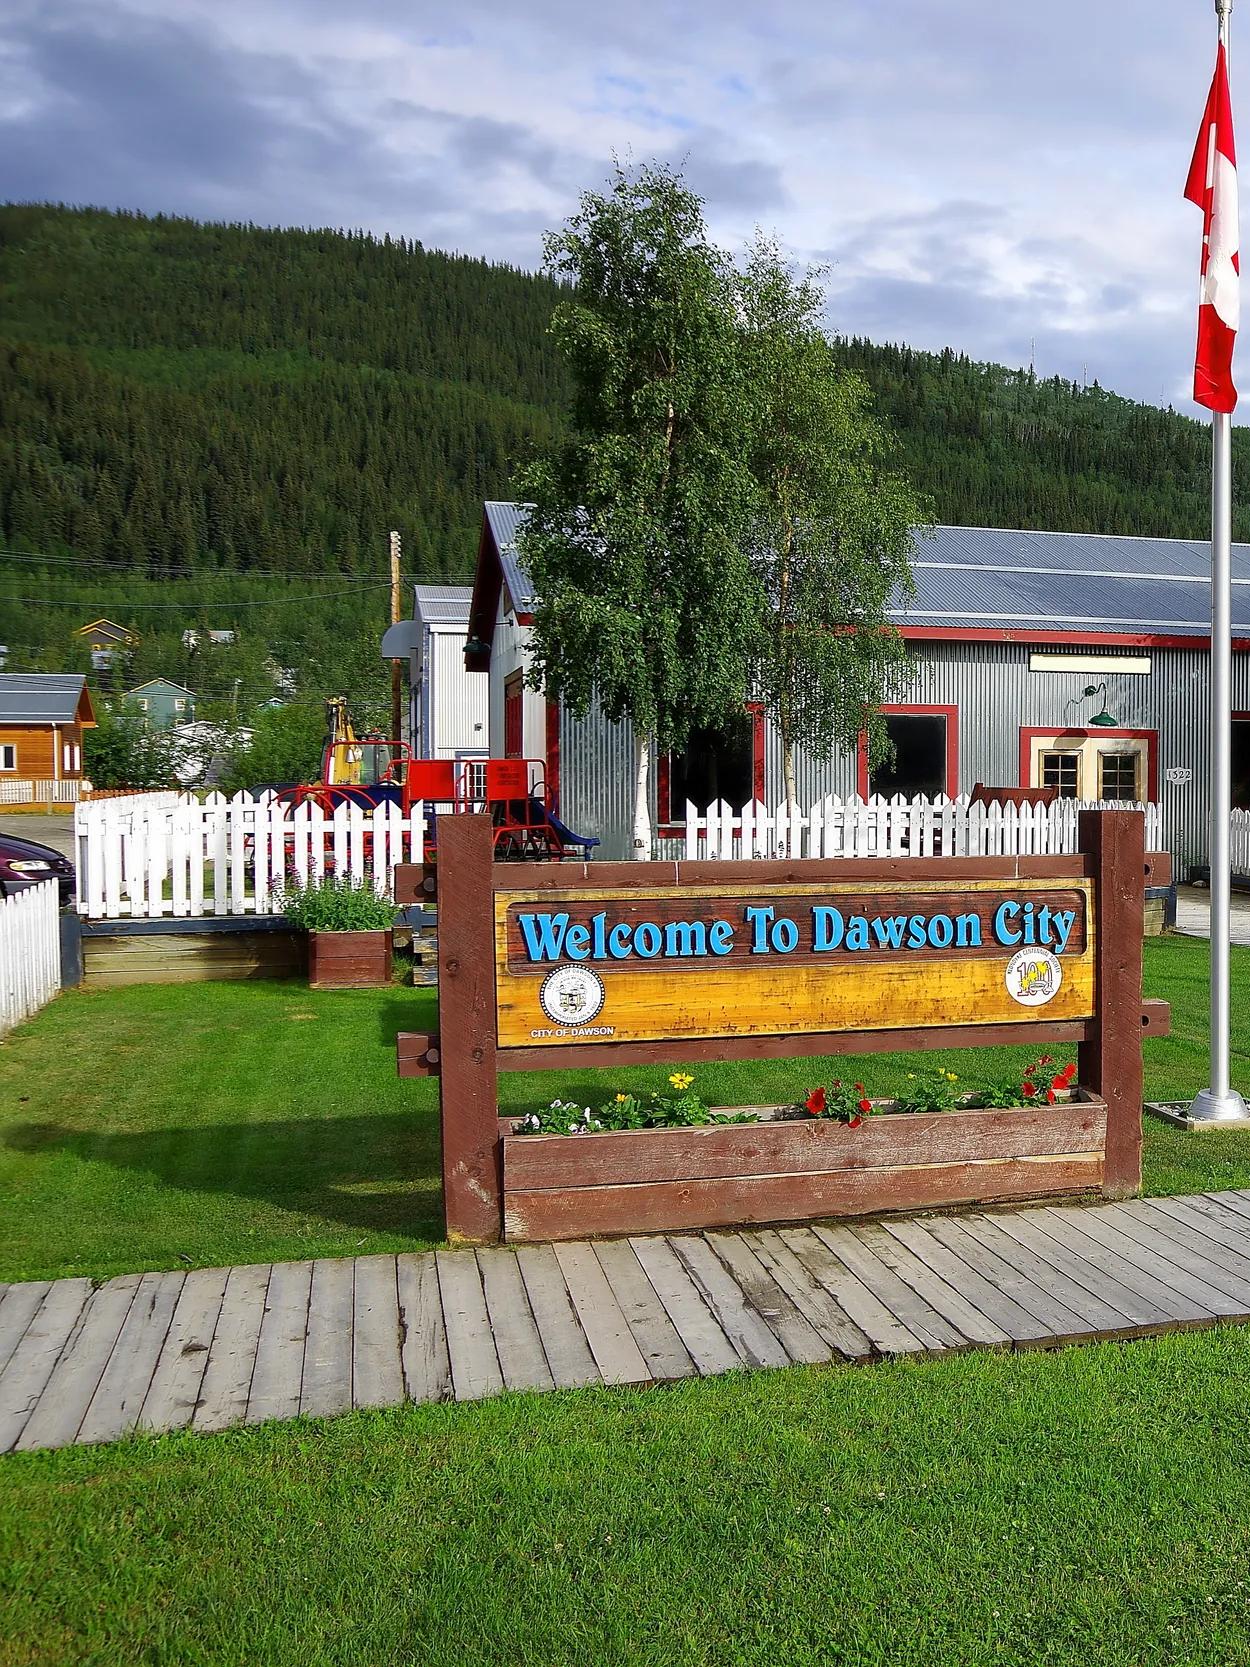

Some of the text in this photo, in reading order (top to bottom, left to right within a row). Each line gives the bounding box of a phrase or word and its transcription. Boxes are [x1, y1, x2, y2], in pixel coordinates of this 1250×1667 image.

[518, 900, 1076, 961] Welcome To Dawson City
[531, 1026, 614, 1038] CITY OF DAWSON
